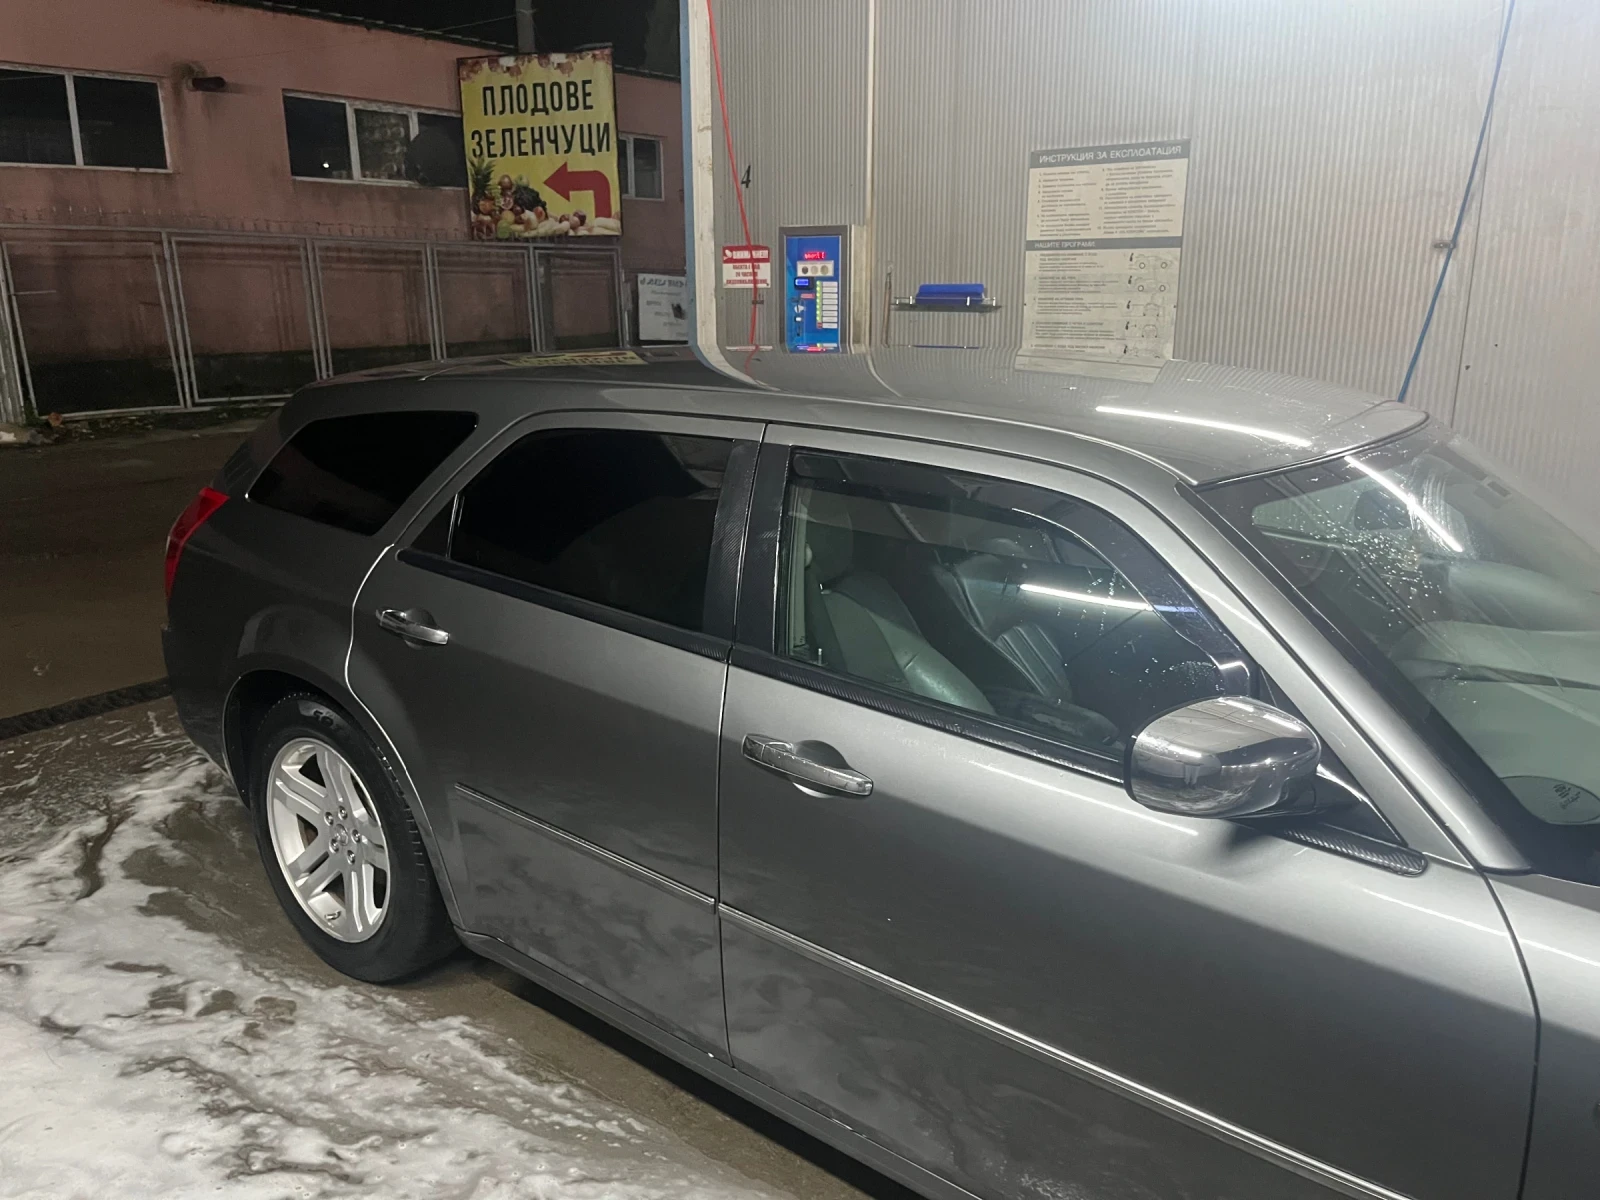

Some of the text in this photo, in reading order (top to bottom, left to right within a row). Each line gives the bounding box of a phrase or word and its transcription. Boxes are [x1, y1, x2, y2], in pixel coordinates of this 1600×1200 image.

[482, 79, 594, 116] ПЛОДОВЕ
[471, 122, 611, 159] ЗЕЛЕНЧУЦИ
[1039, 145, 1182, 164] ИНСТРУКЦИЯ ЗА ЕКСПЛОАТАЦИЯ
[740, 164, 751, 188] 4
[1034, 241, 1060, 249] НАШИТЕ
